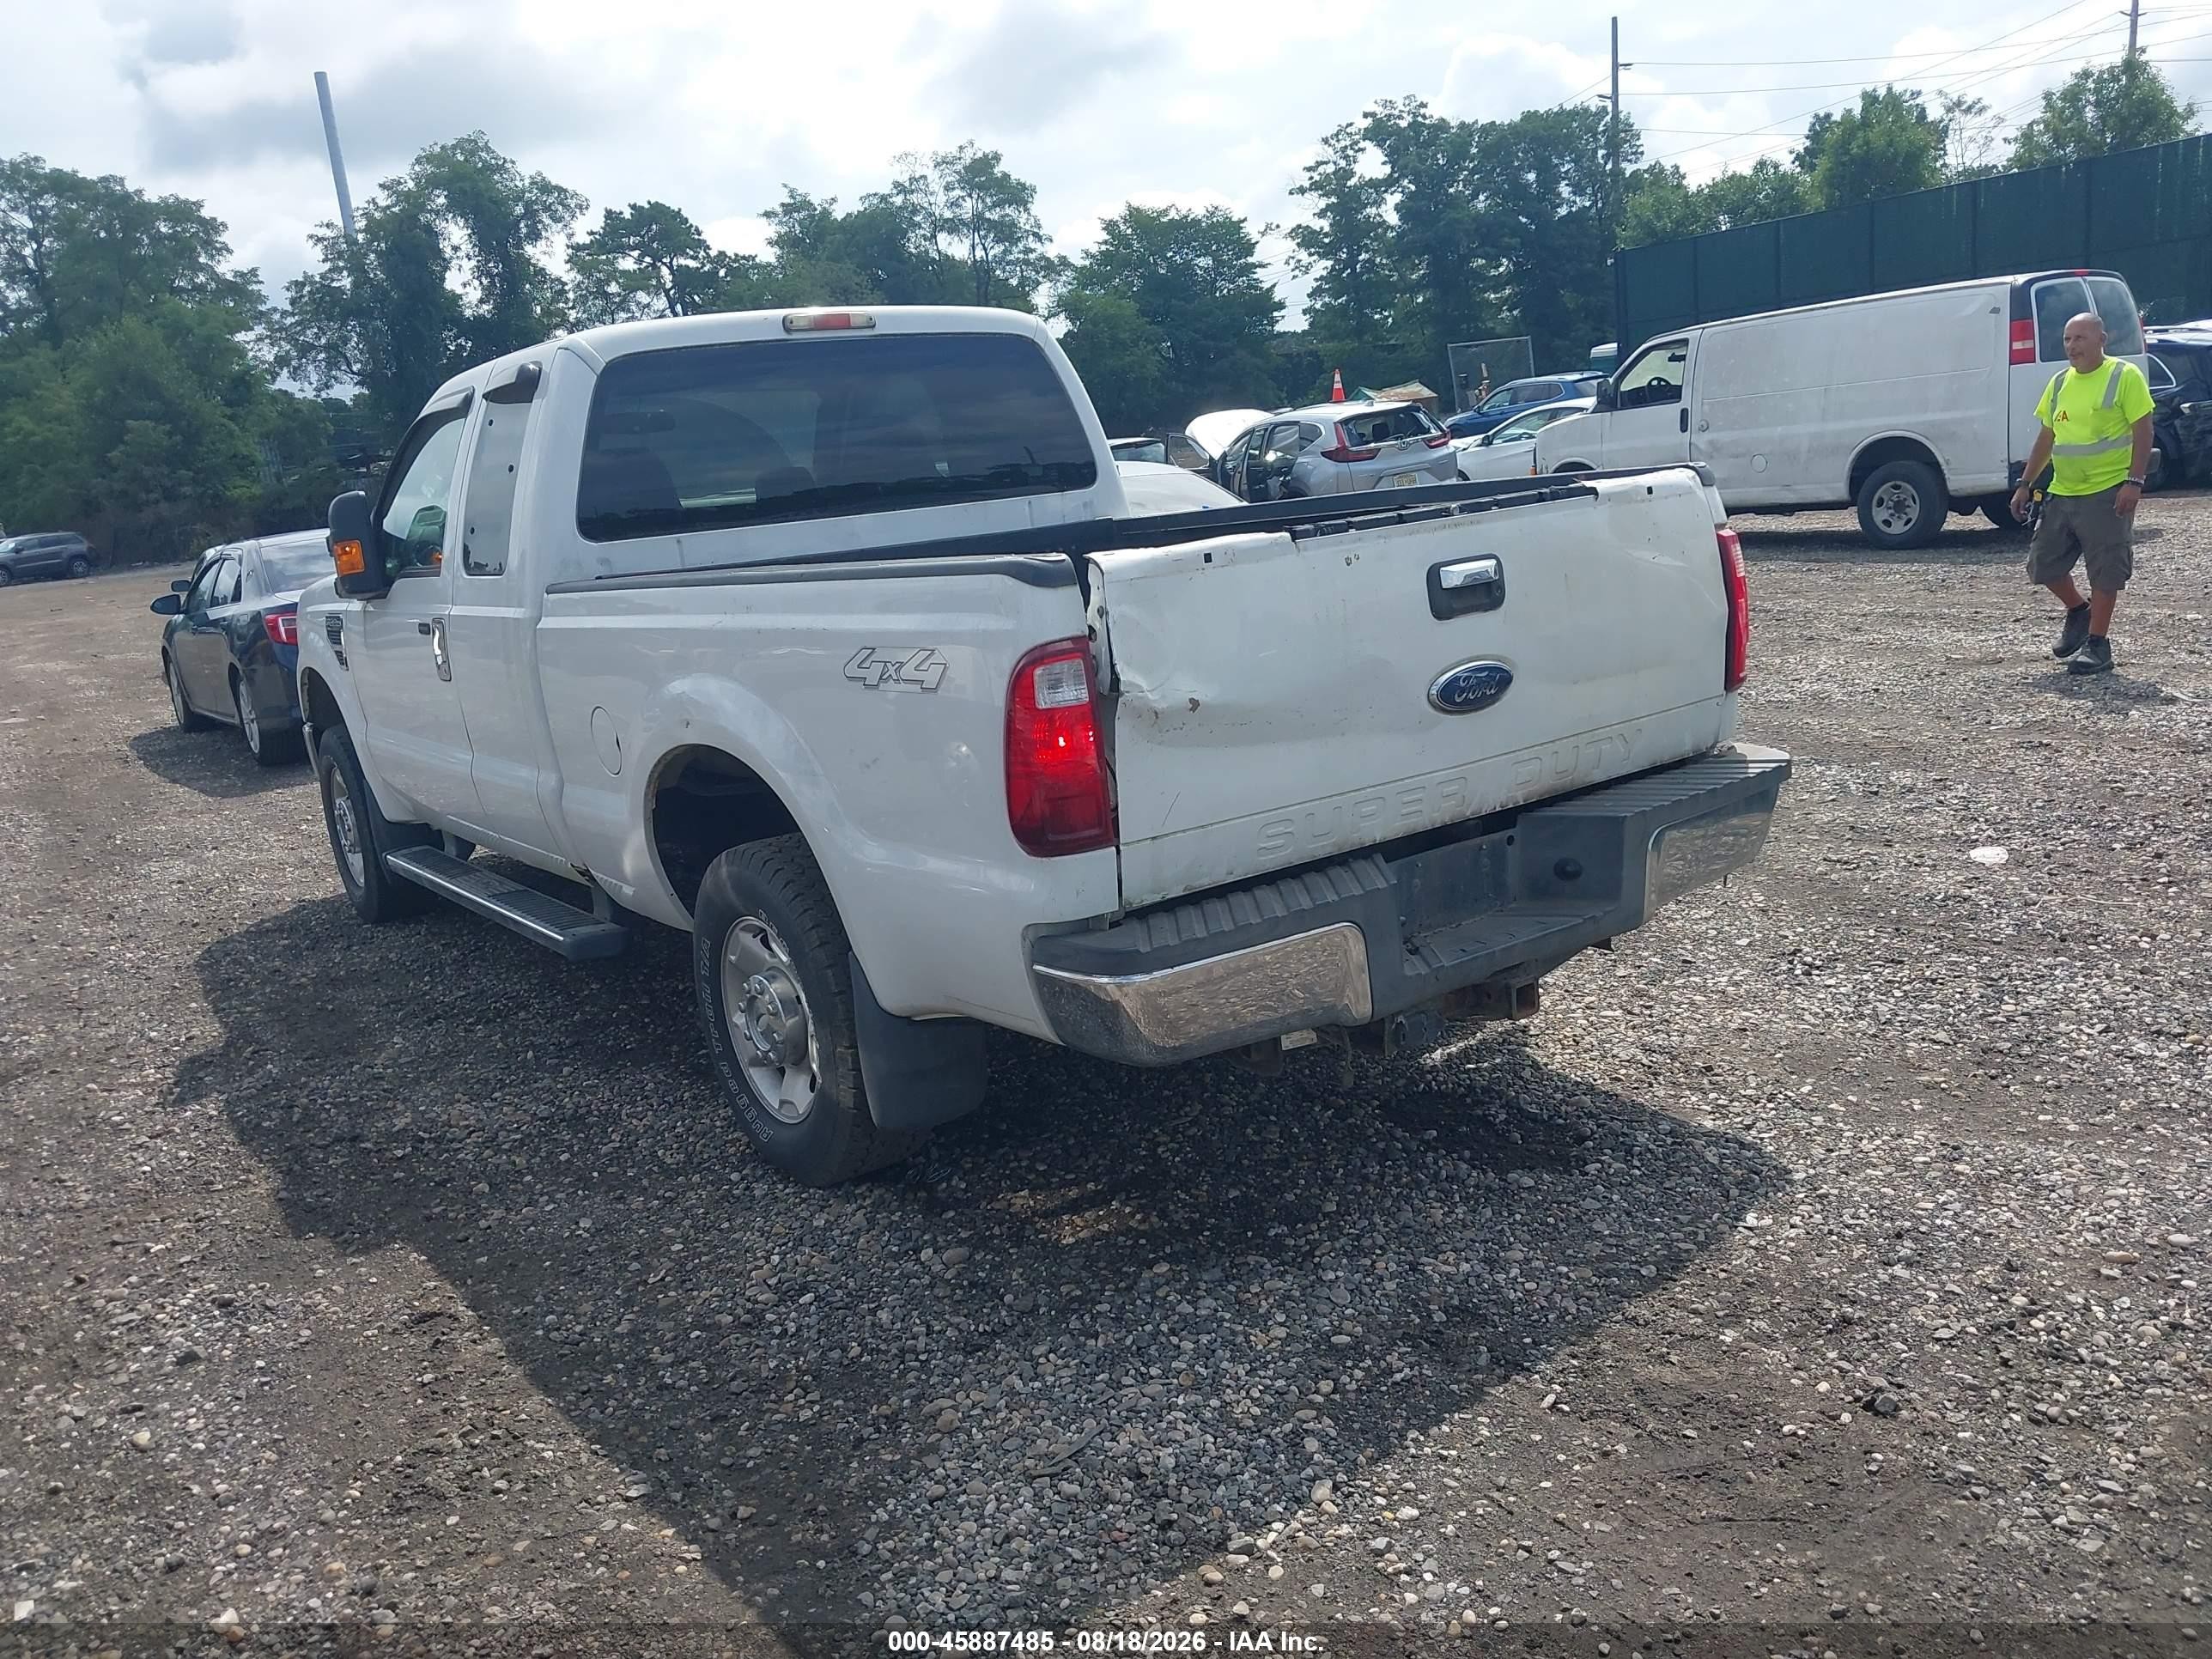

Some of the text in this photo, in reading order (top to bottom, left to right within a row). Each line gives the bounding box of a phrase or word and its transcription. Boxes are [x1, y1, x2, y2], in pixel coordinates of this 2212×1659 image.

[1453, 671, 1500, 702] Ford
[1256, 728, 1643, 859] SUPER DUTY
